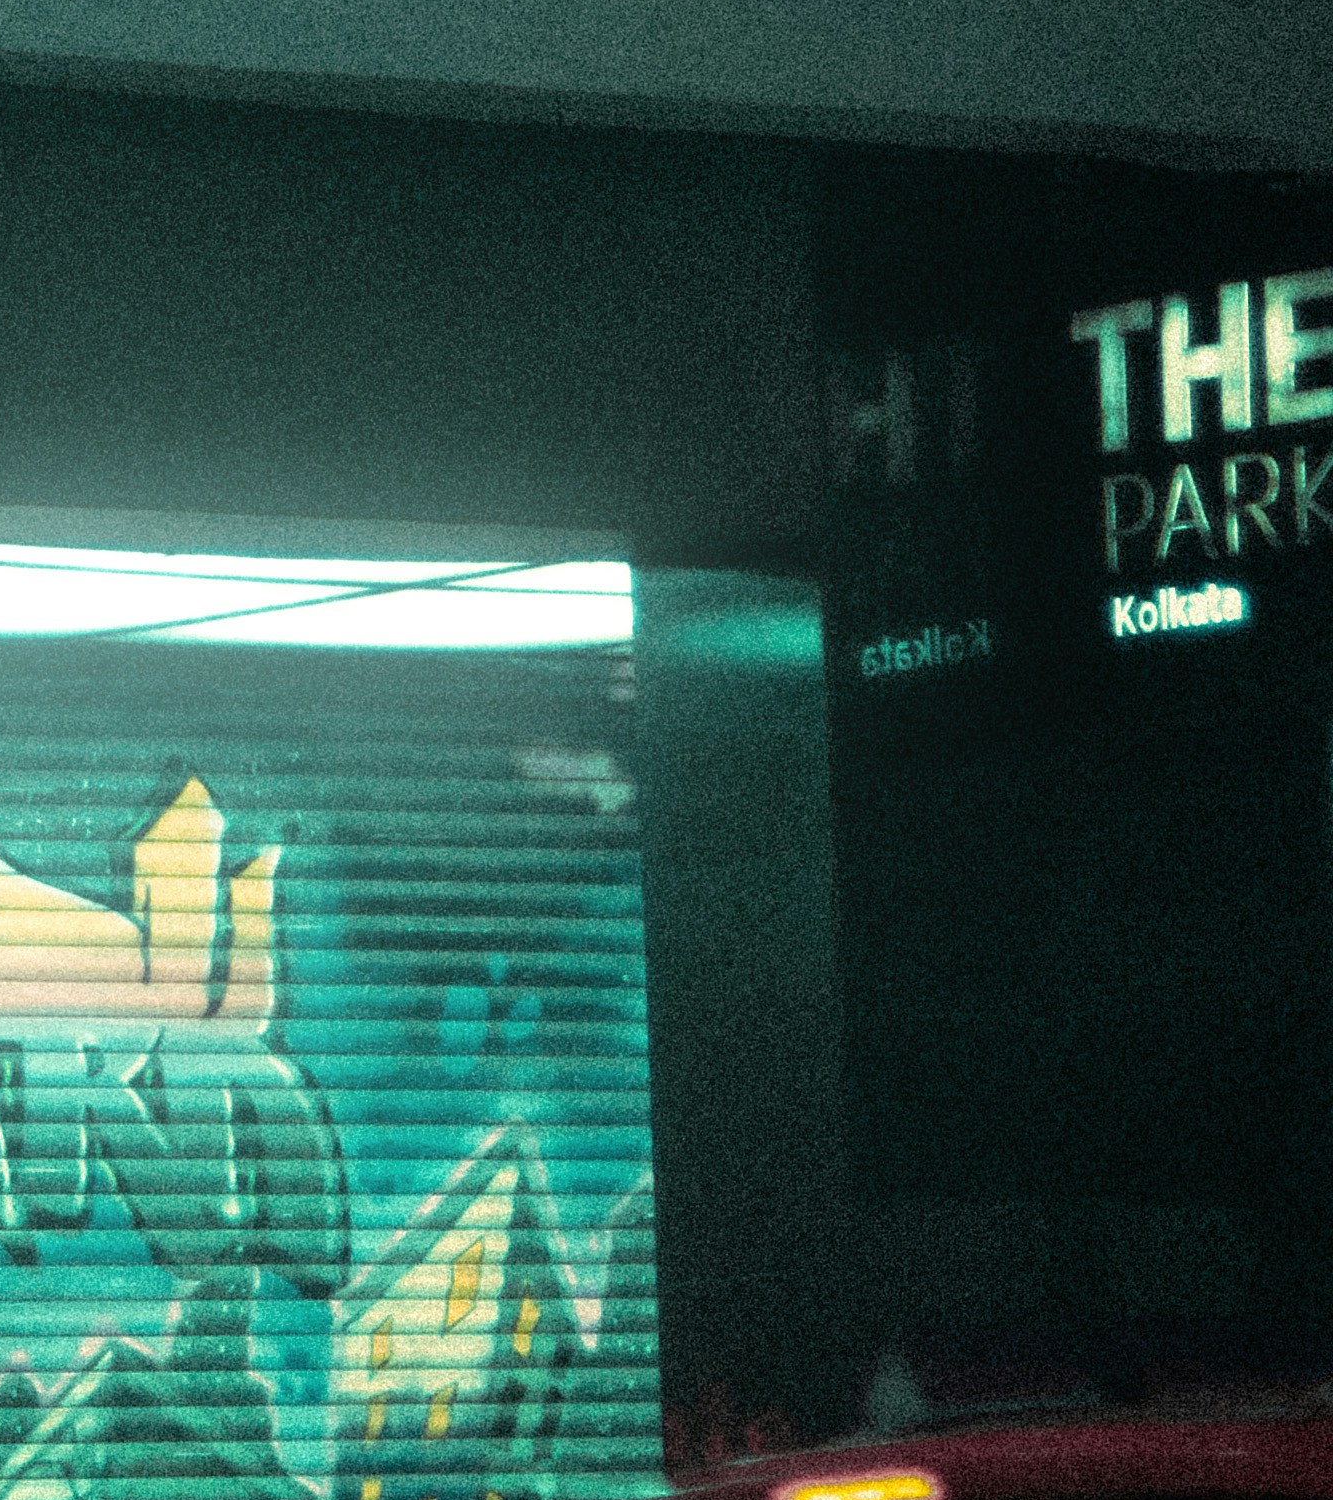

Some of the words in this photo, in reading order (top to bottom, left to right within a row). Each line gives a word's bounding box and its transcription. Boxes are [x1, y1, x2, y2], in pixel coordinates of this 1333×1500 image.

[1069, 266, 1333, 452] THE
[1102, 447, 1333, 572] PARK
[1111, 584, 1244, 637] Kolkata
